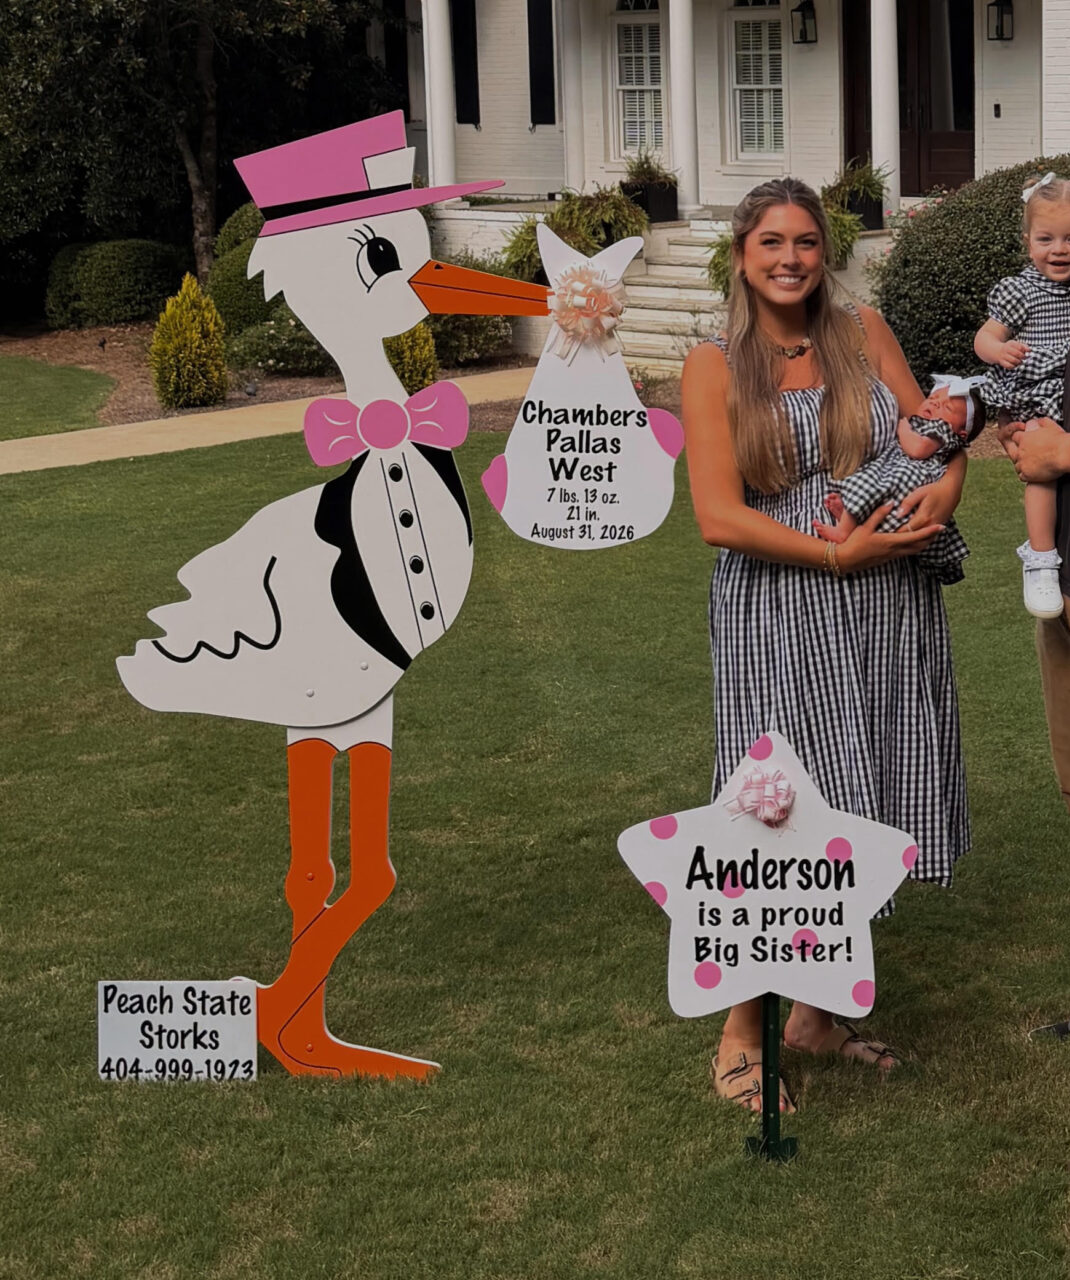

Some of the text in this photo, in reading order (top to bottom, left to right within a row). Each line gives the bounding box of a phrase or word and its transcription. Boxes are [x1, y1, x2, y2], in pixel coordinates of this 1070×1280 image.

[522, 400, 648, 427] Chambers
[546, 429, 621, 455] Pallas
[549, 458, 617, 483] West
[547, 487, 620, 505] 7 lbs. 13 oz.
[566, 505, 600, 522] 21 in.
[531, 522, 635, 541] August 31, 2026
[685, 846, 855, 891] Anderson
[698, 901, 844, 932] is a proud
[694, 935, 852, 967] Big Sister!
[103, 984, 252, 1016] Peach State
[139, 1020, 220, 1050] Storks
